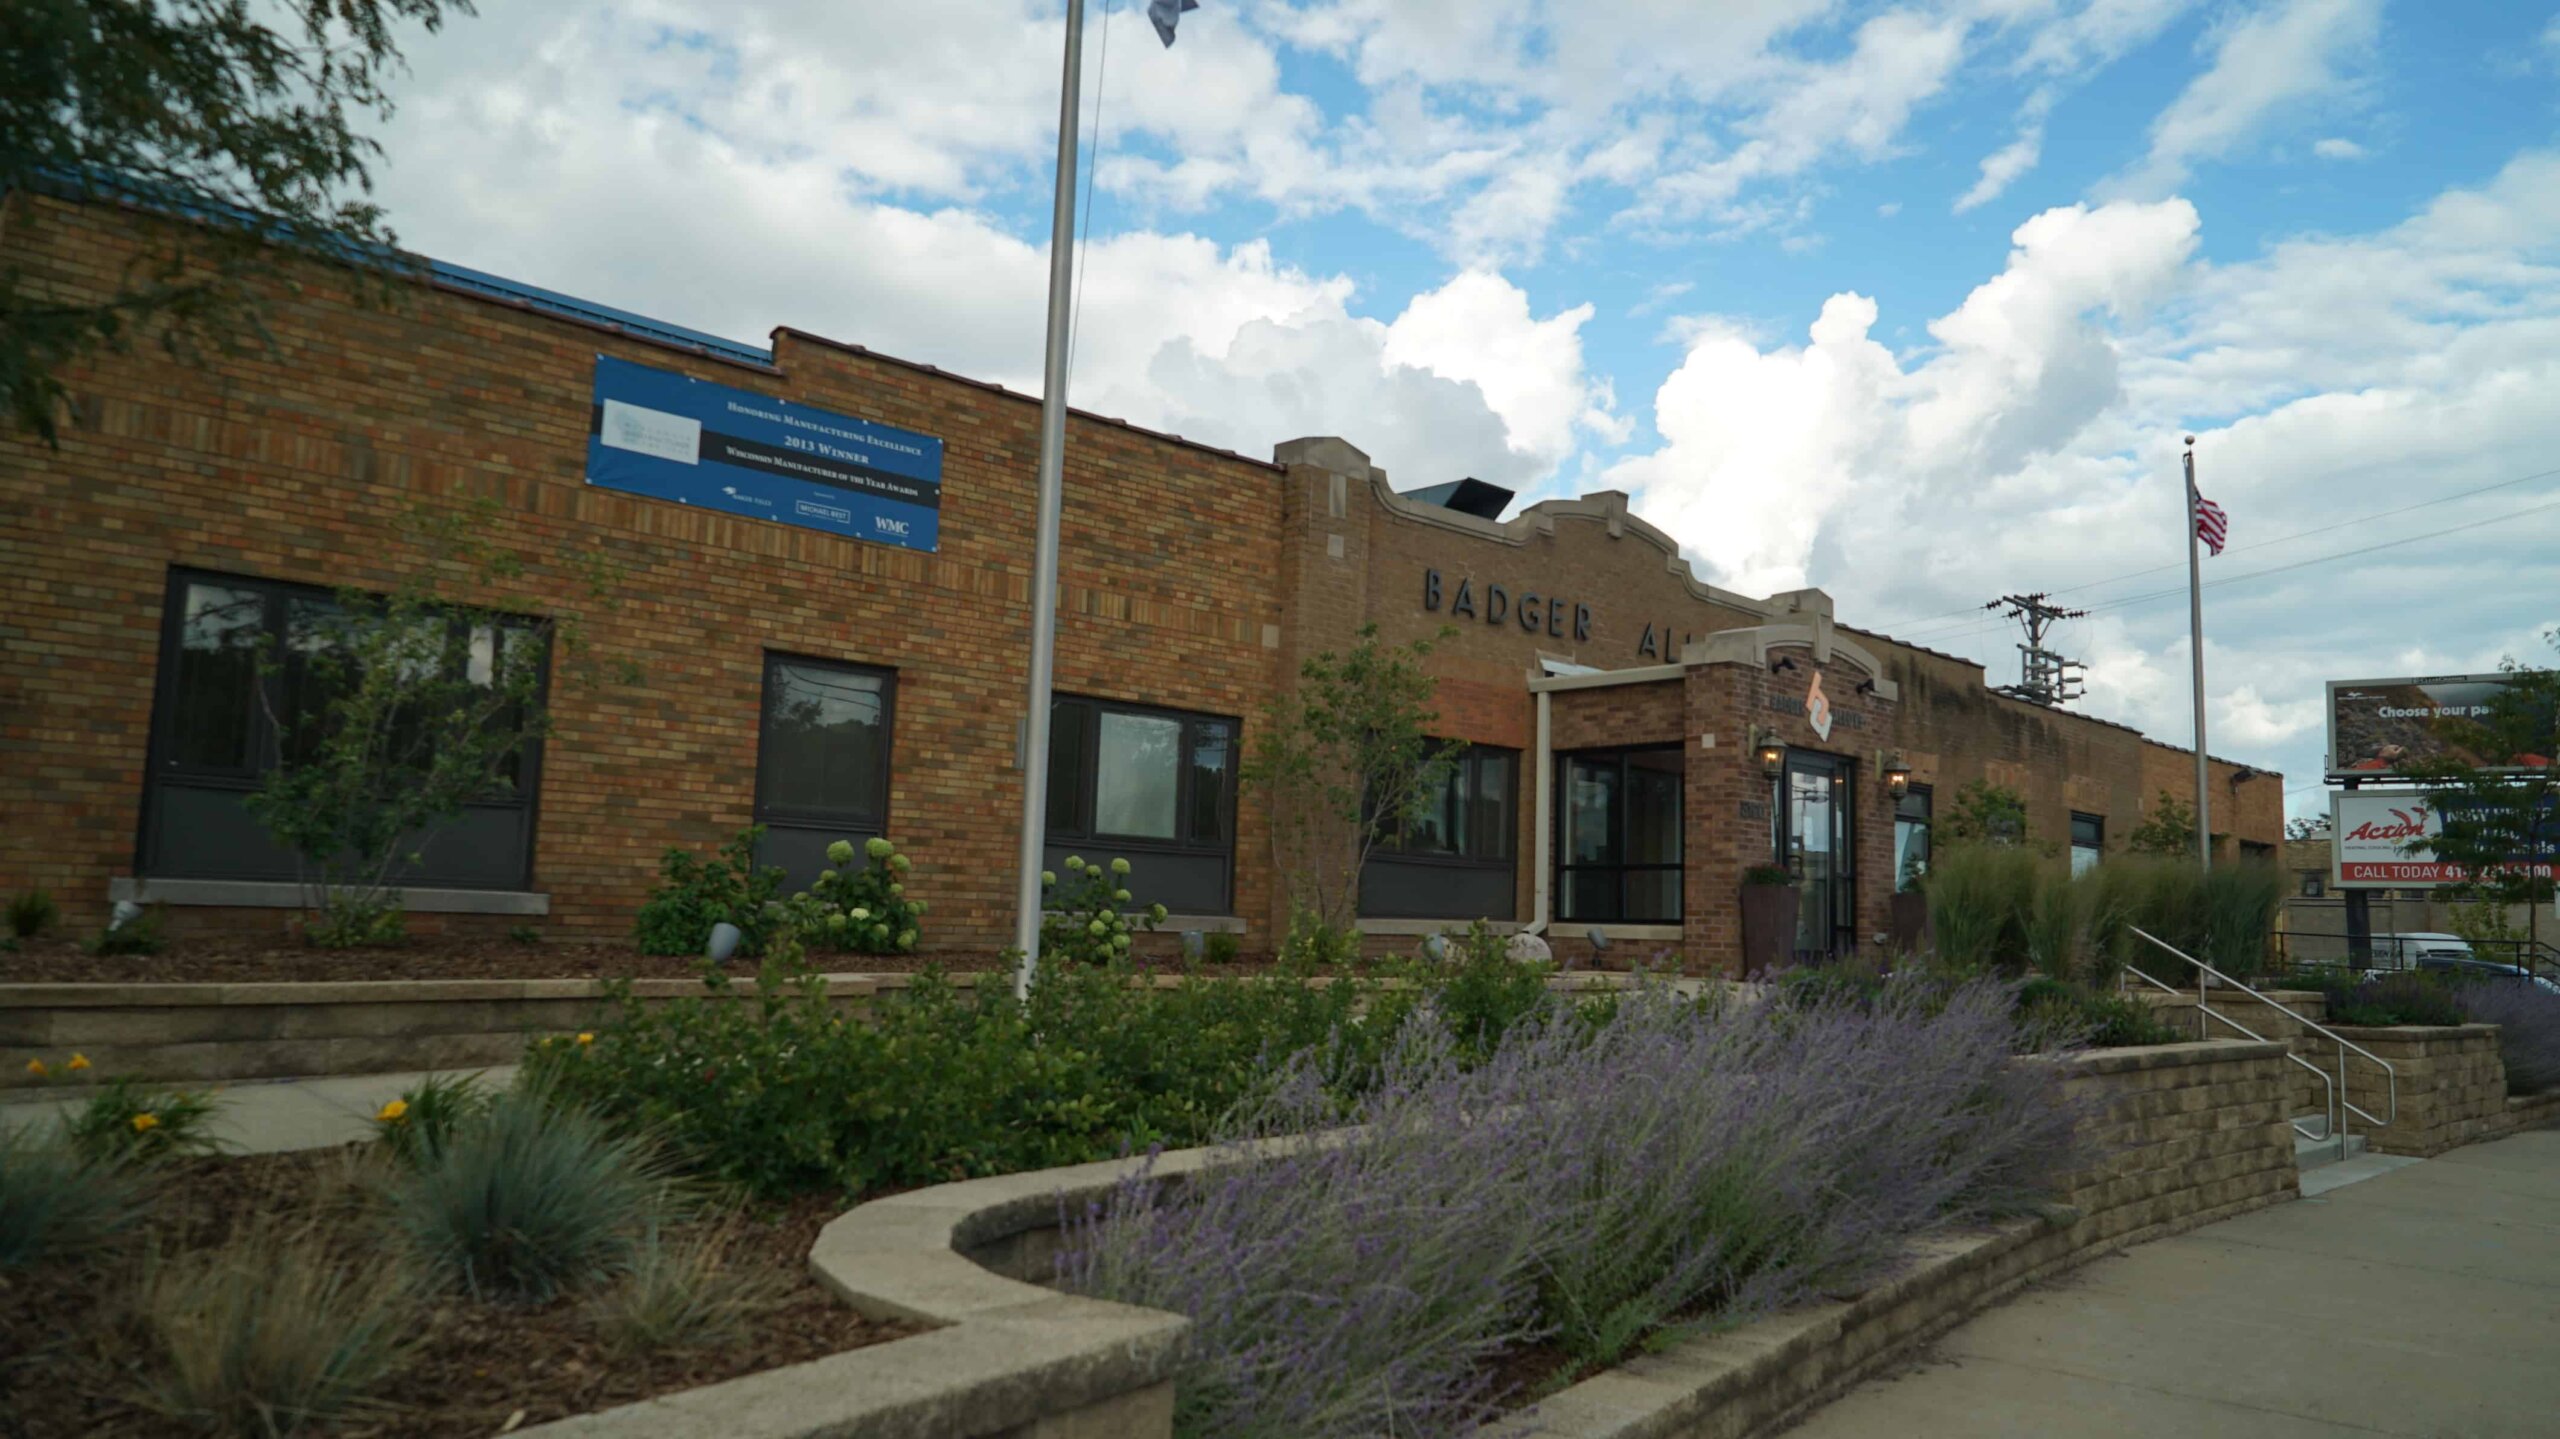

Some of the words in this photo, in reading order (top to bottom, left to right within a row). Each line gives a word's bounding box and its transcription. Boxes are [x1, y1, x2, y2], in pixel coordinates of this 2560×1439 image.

[727, 401, 781, 423] HONORING
[783, 414, 865, 443] MANUFACTURING
[866, 435, 922, 456] EXCELLENCE
[784, 435, 815, 452] 2013
[818, 443, 870, 465] WINNER
[865, 476, 886, 490] YEAR
[875, 516, 910, 534] WMC
[1425, 568, 1592, 642] BADGER
[1638, 621, 1691, 664] AL
[2378, 706, 2429, 718] Choose
[2433, 705, 2466, 719] your
[2470, 705, 2493, 718] pa
[2344, 821, 2425, 841] Action
[2354, 866, 2388, 878] CALL
[2392, 866, 2440, 878] TODAY
